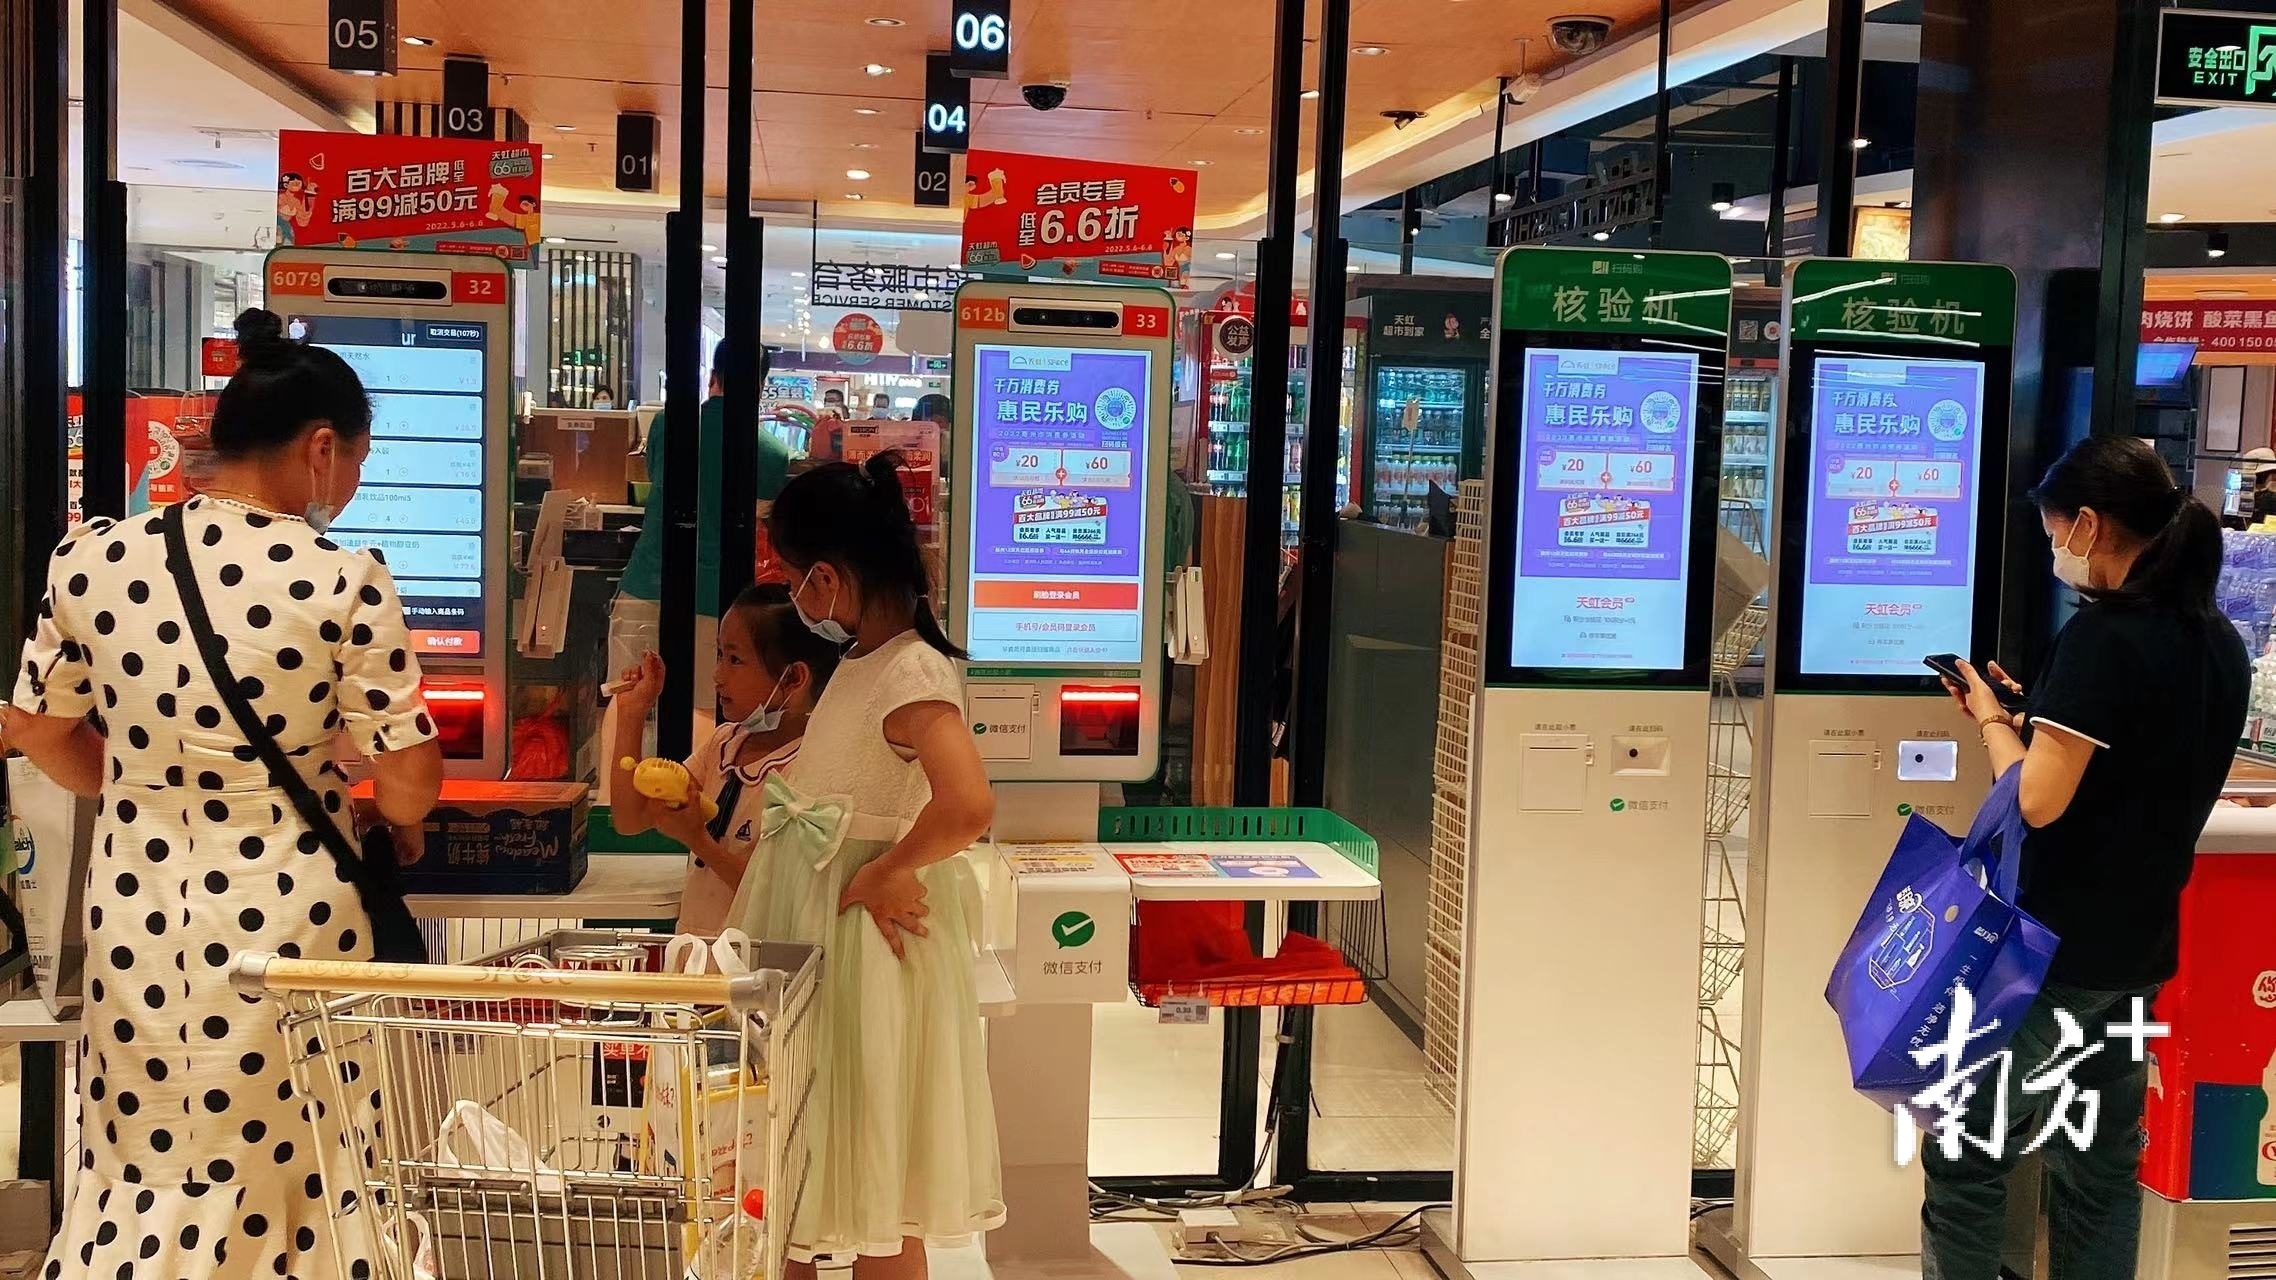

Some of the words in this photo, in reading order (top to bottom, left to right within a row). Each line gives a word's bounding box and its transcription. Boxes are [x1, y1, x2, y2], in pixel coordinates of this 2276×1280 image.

[335, 19, 378, 49] 05
[956, 14, 1004, 50] 06
[2188, 48, 2246, 70] 安全出口
[2194, 71, 2238, 86] EXIT
[448, 108, 483, 132] 03
[928, 104, 966, 132] 04
[622, 154, 648, 175] 01
[348, 162, 450, 193] 百大品牌
[918, 171, 945, 191] 02
[1037, 180, 1126, 205] 会员专享
[332, 187, 477, 223] 满99减50元
[1019, 212, 1036, 246] 低至
[1040, 205, 1139, 244] 6.6折
[274, 271, 321, 286] 6079
[469, 280, 492, 295] 32
[1553, 285, 1679, 325] 核验机
[962, 306, 1006, 321] 612b
[1136, 314, 1157, 328] 33
[1394, 314, 1416, 325] 天虹
[1841, 296, 1966, 335] 核验机
[1228, 325, 1249, 336] 公益
[1383, 325, 1425, 337] 超市到家
[1227, 336, 1249, 346] 发声
[2211, 337, 2236, 347] 400
[2240, 337, 2262, 347] 150
[994, 378, 1060, 395] 千万消费券
[997, 400, 1088, 424] 惠民乐购
[1545, 403, 1633, 427] 惠民乐购
[1834, 413, 1921, 435] 惠民乐购
[1016, 455, 1039, 468] ¥20
[1086, 456, 1108, 470] ¥60
[1562, 458, 1584, 471] ¥20
[1630, 460, 1652, 473] ¥60
[1576, 596, 1623, 609] 天虹会员
[1865, 603, 1911, 616] 天虹会员
[427, 637, 463, 646] 确认付款
[989, 723, 1026, 734] 微信支付
[1628, 800, 1669, 811] 微信支付
[1915, 805, 1955, 816] 微信支付
[448, 842, 491, 865] 纯牛奶
[495, 837, 559, 862] Meadow
[1043, 960, 1102, 976] 微信支付
